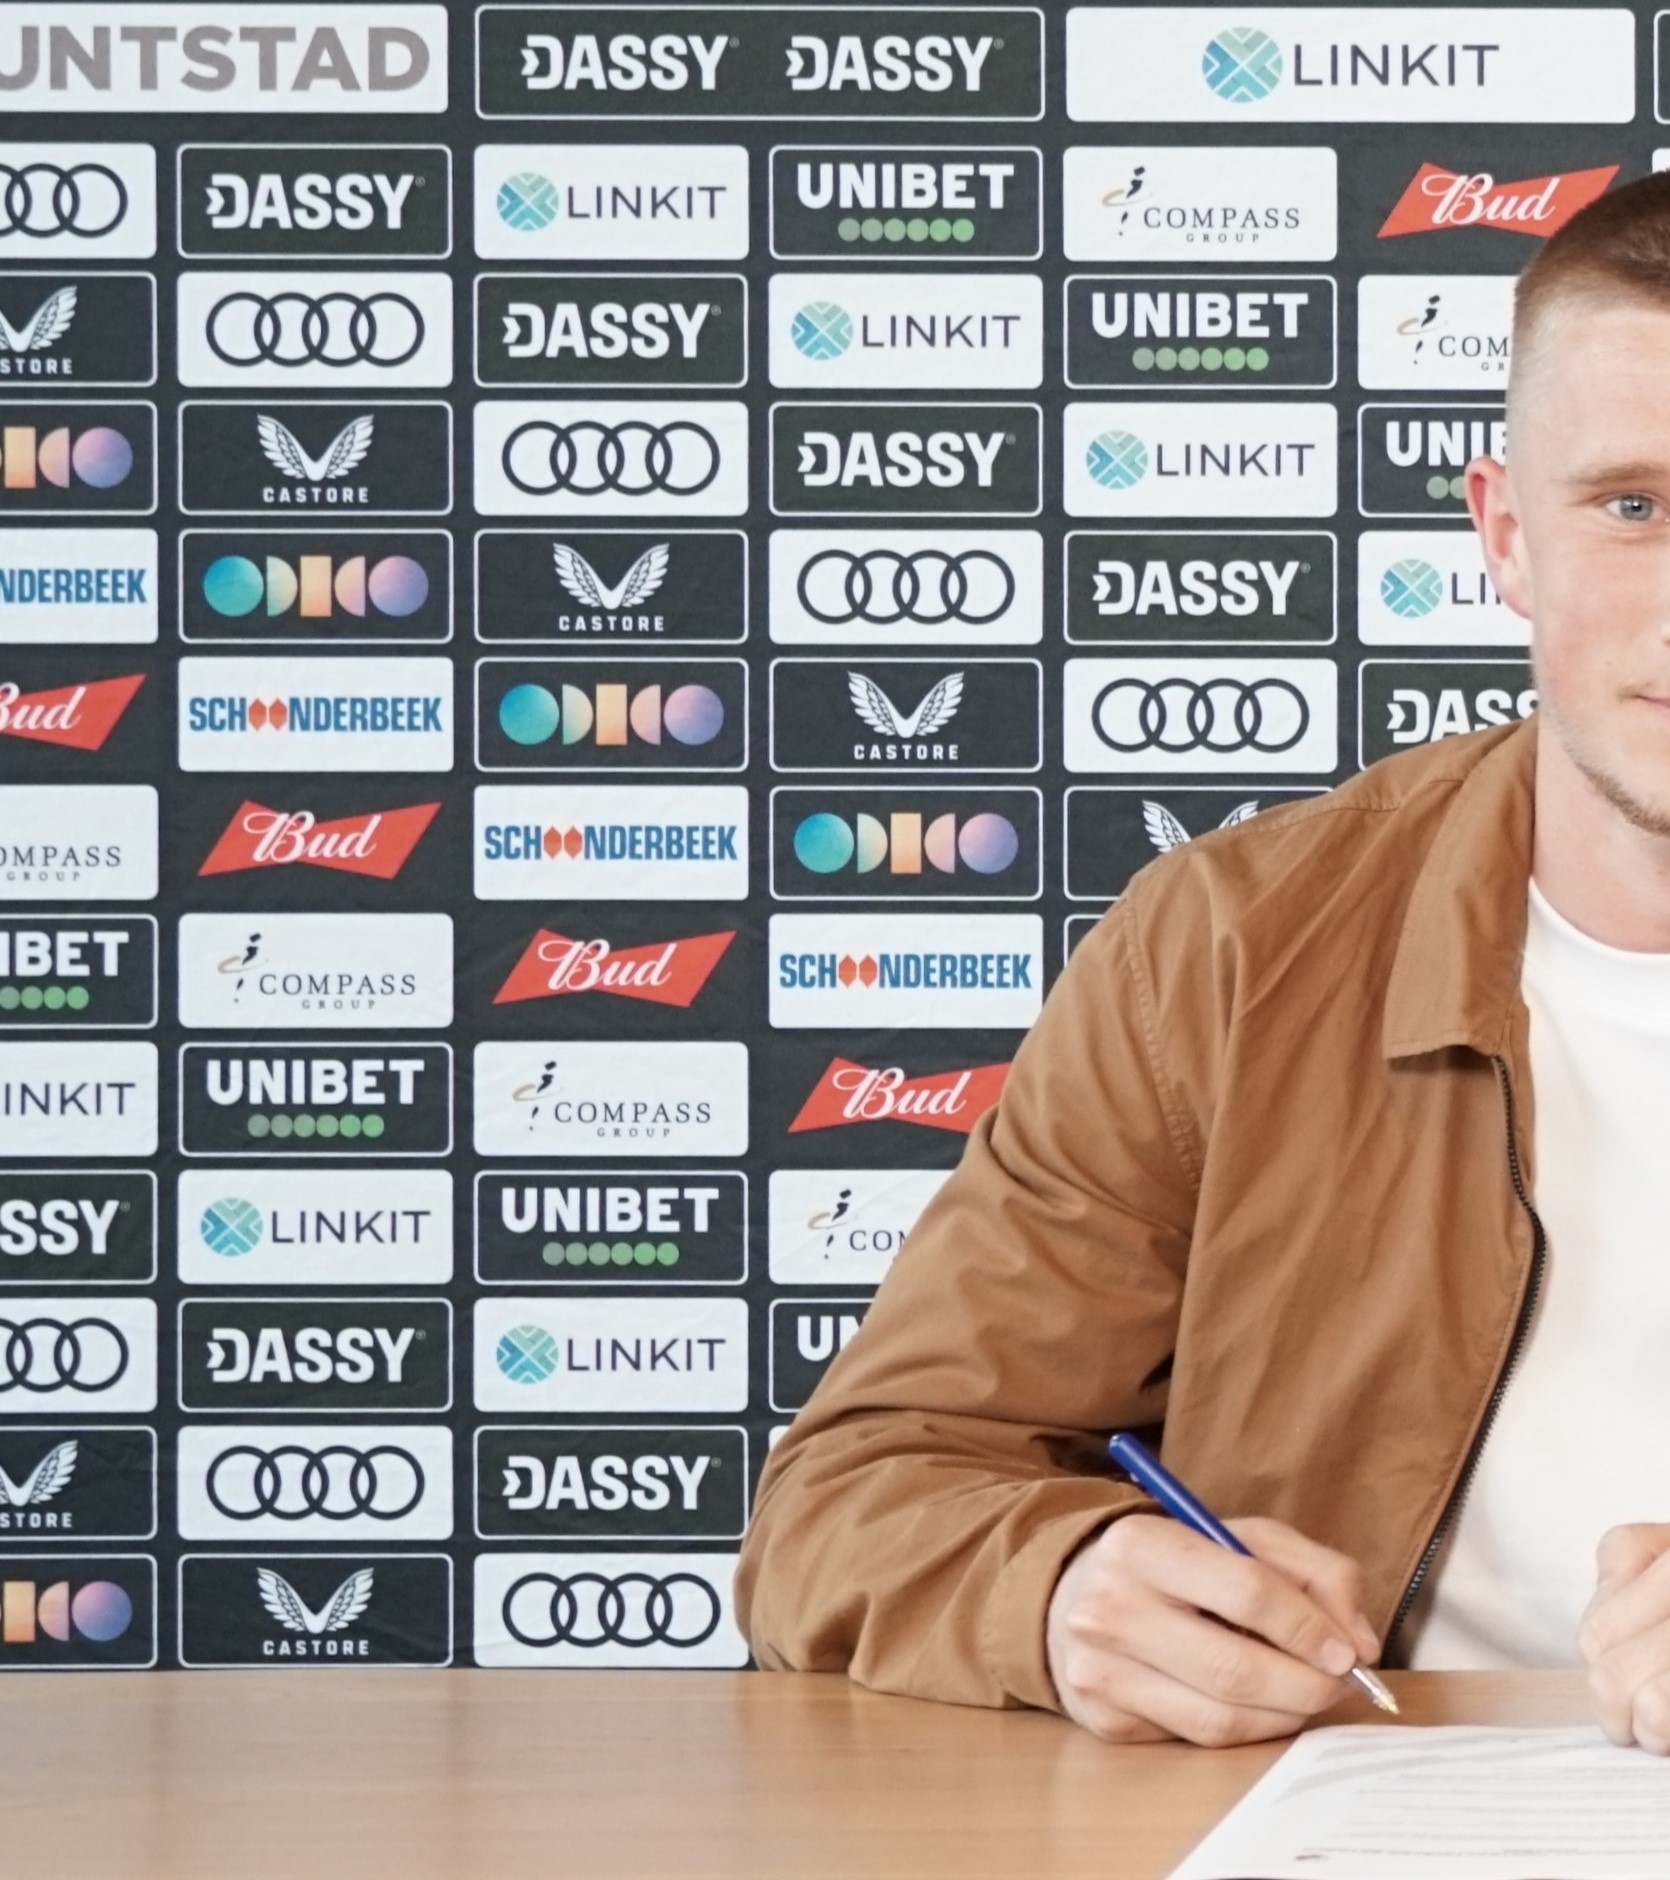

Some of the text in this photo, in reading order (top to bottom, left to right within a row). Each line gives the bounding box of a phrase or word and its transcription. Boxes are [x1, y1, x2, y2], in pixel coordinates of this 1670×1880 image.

[1294, 44, 1499, 86] LINKIT
[568, 186, 726, 218] LINKIT
[798, 163, 1014, 209] UNIBET
[1422, 173, 1560, 224] Bud
[1144, 207, 1299, 228] COMPASS
[1186, 233, 1259, 243] GROUP
[1092, 292, 1308, 338] UNIBET
[863, 315, 1020, 348] LINKIT
[0, 358, 72, 374] STORE
[1157, 444, 1315, 476] LINKIT
[263, 487, 368, 503] CASTORE
[0, 569, 146, 603] NDERBEEK
[559, 616, 663, 631] CASTORE
[854, 744, 958, 760] CASTORE
[243, 811, 381, 862] Bud
[0, 846, 120, 867] OMPASS
[6, 871, 80, 881] GROUP
[0, 931, 129, 976] IBET
[538, 939, 676, 990] Bud
[259, 974, 415, 995] COMPASS
[302, 999, 375, 1010] GROUP
[207, 1059, 424, 1105] UNIBET
[833, 1068, 971, 1118] Bud
[0, 1083, 136, 1115] INKIT
[554, 1102, 710, 1123] COMPASS
[597, 1127, 670, 1138] GROUP
[502, 1187, 719, 1233] UNIBET
[0, 1200, 119, 1255] SSY
[272, 1211, 431, 1243] LINKIT
[568, 1338, 726, 1371] LINKIT
[0, 1512, 72, 1528] STORE
[263, 1640, 368, 1655] CASTORE
